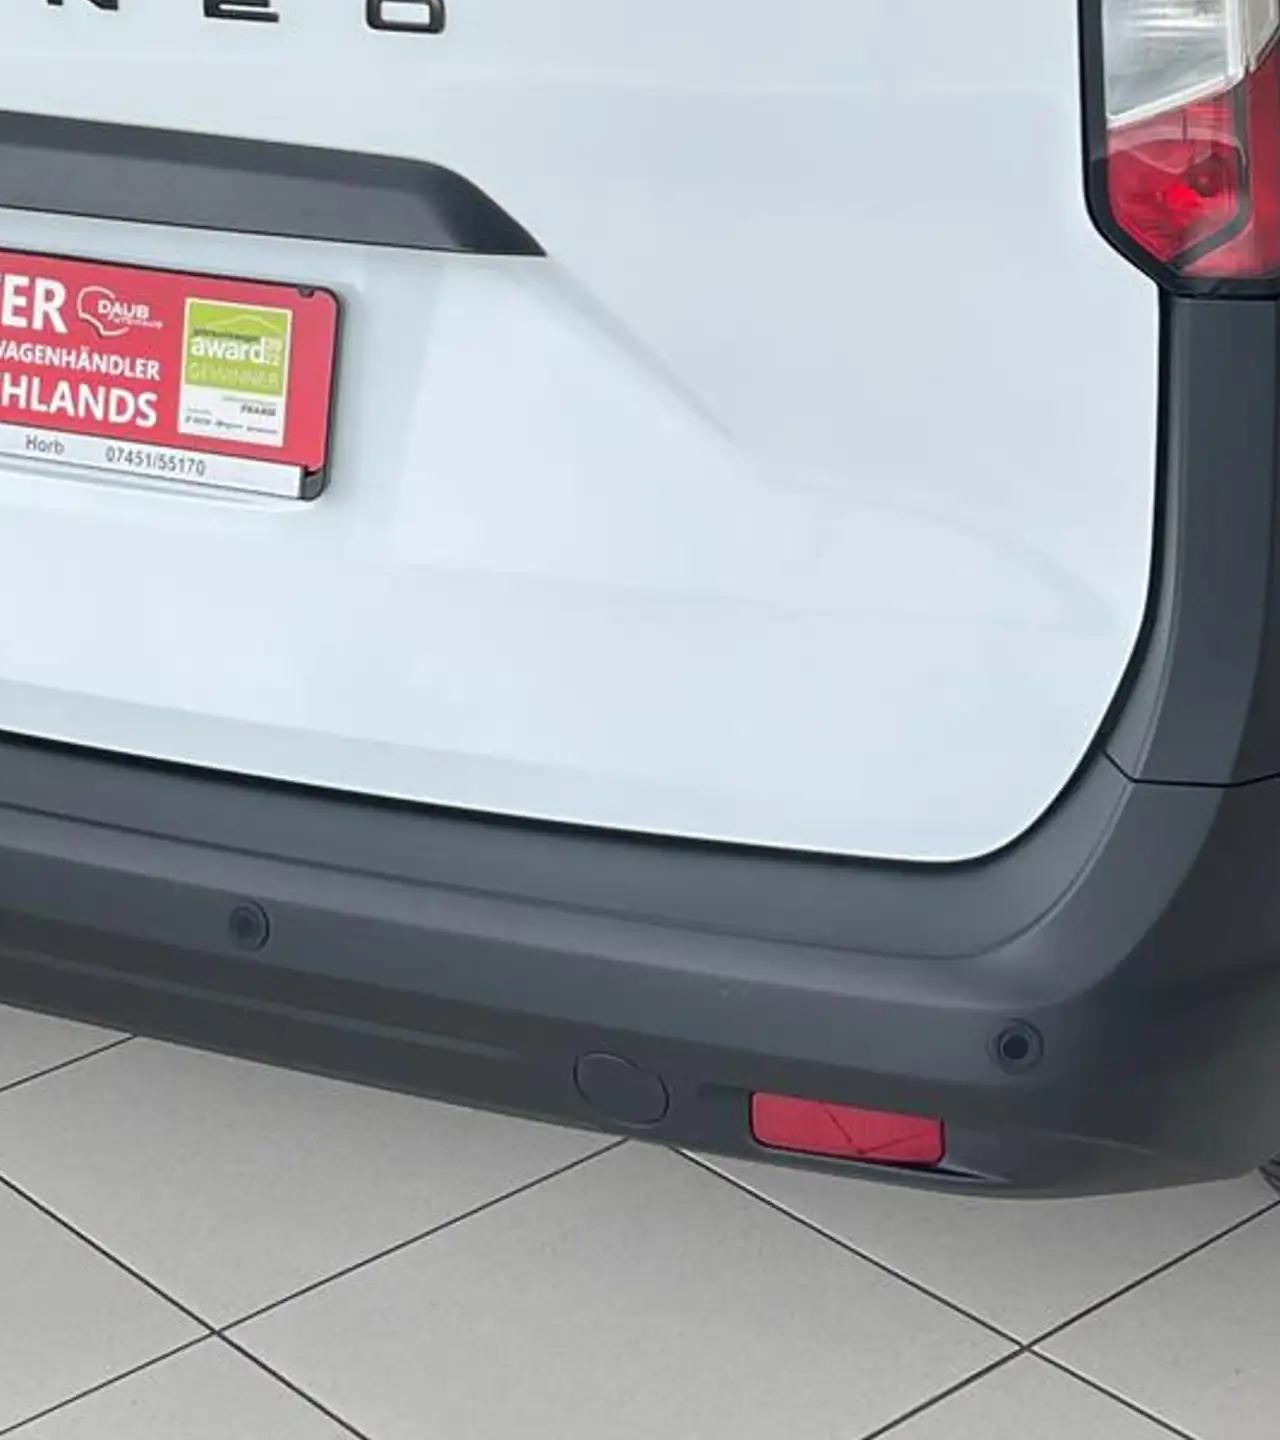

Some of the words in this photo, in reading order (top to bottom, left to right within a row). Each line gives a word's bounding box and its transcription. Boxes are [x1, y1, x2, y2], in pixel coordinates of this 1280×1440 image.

[97, 298, 150, 320] DAUB
[191, 335, 266, 365] award
[25, 433, 65, 455] Horb
[105, 445, 206, 477] 07451/55170
